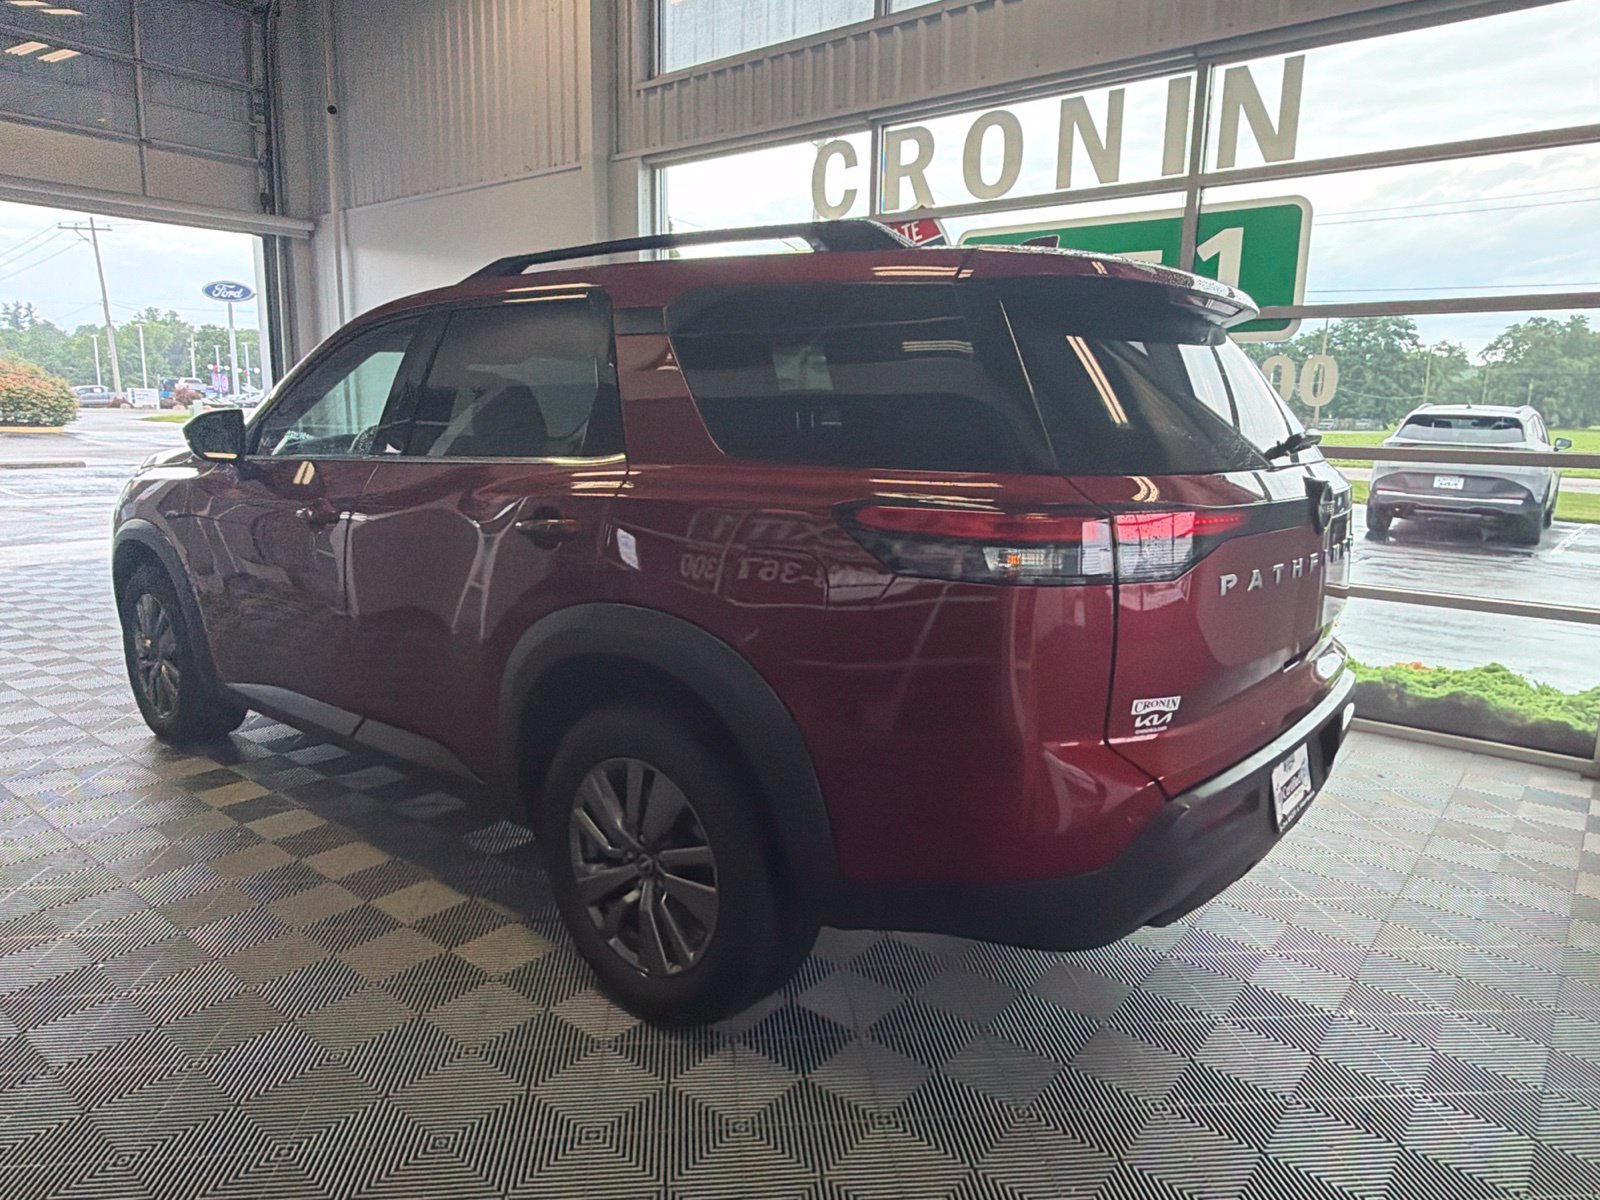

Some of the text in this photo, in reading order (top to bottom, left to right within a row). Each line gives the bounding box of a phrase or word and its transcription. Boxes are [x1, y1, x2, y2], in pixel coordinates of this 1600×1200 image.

[811, 54, 1306, 220] CRONIN
[212, 283, 243, 298] Ford
[1134, 697, 1179, 714] CRONIN
